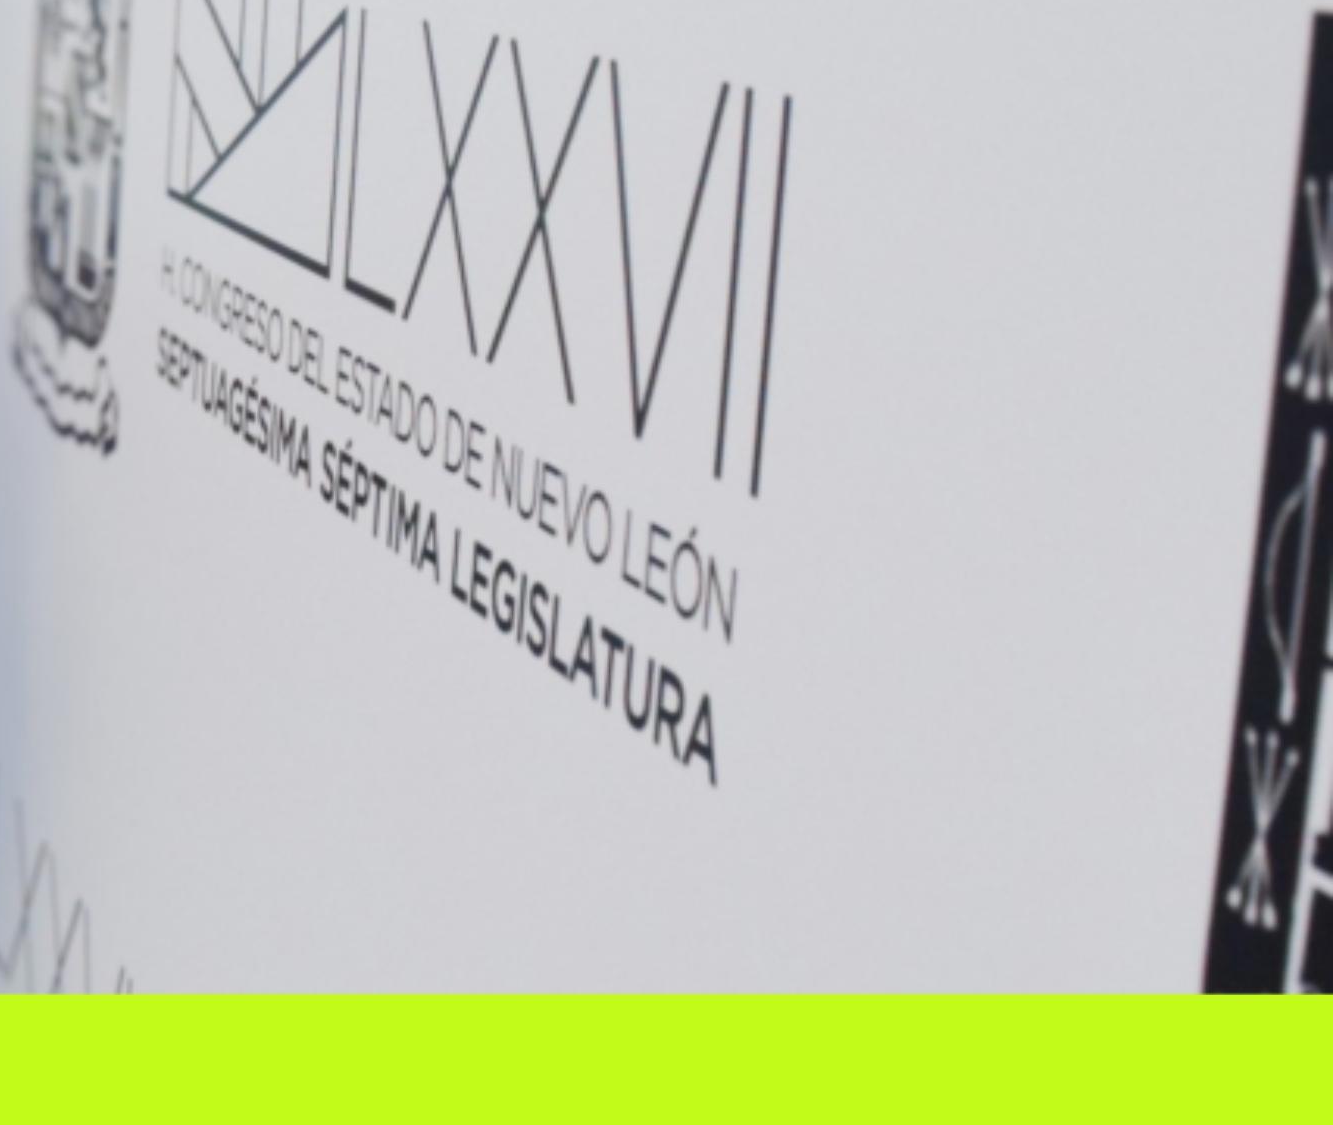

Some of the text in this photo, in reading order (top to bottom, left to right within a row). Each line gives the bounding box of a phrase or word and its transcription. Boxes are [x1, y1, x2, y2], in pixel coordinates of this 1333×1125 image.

[180, 255, 283, 363] CONGRESO
[288, 317, 331, 395] DEL
[335, 344, 438, 458] ESTADO
[443, 407, 487, 491] DE
[490, 434, 613, 565] NUEVO
[620, 508, 737, 646] LEÓN
[343, 7, 793, 498] LXXVII
[156, 325, 718, 787] SEPTUAGÉSIMA SÉPTIMA LEGISLATURA
